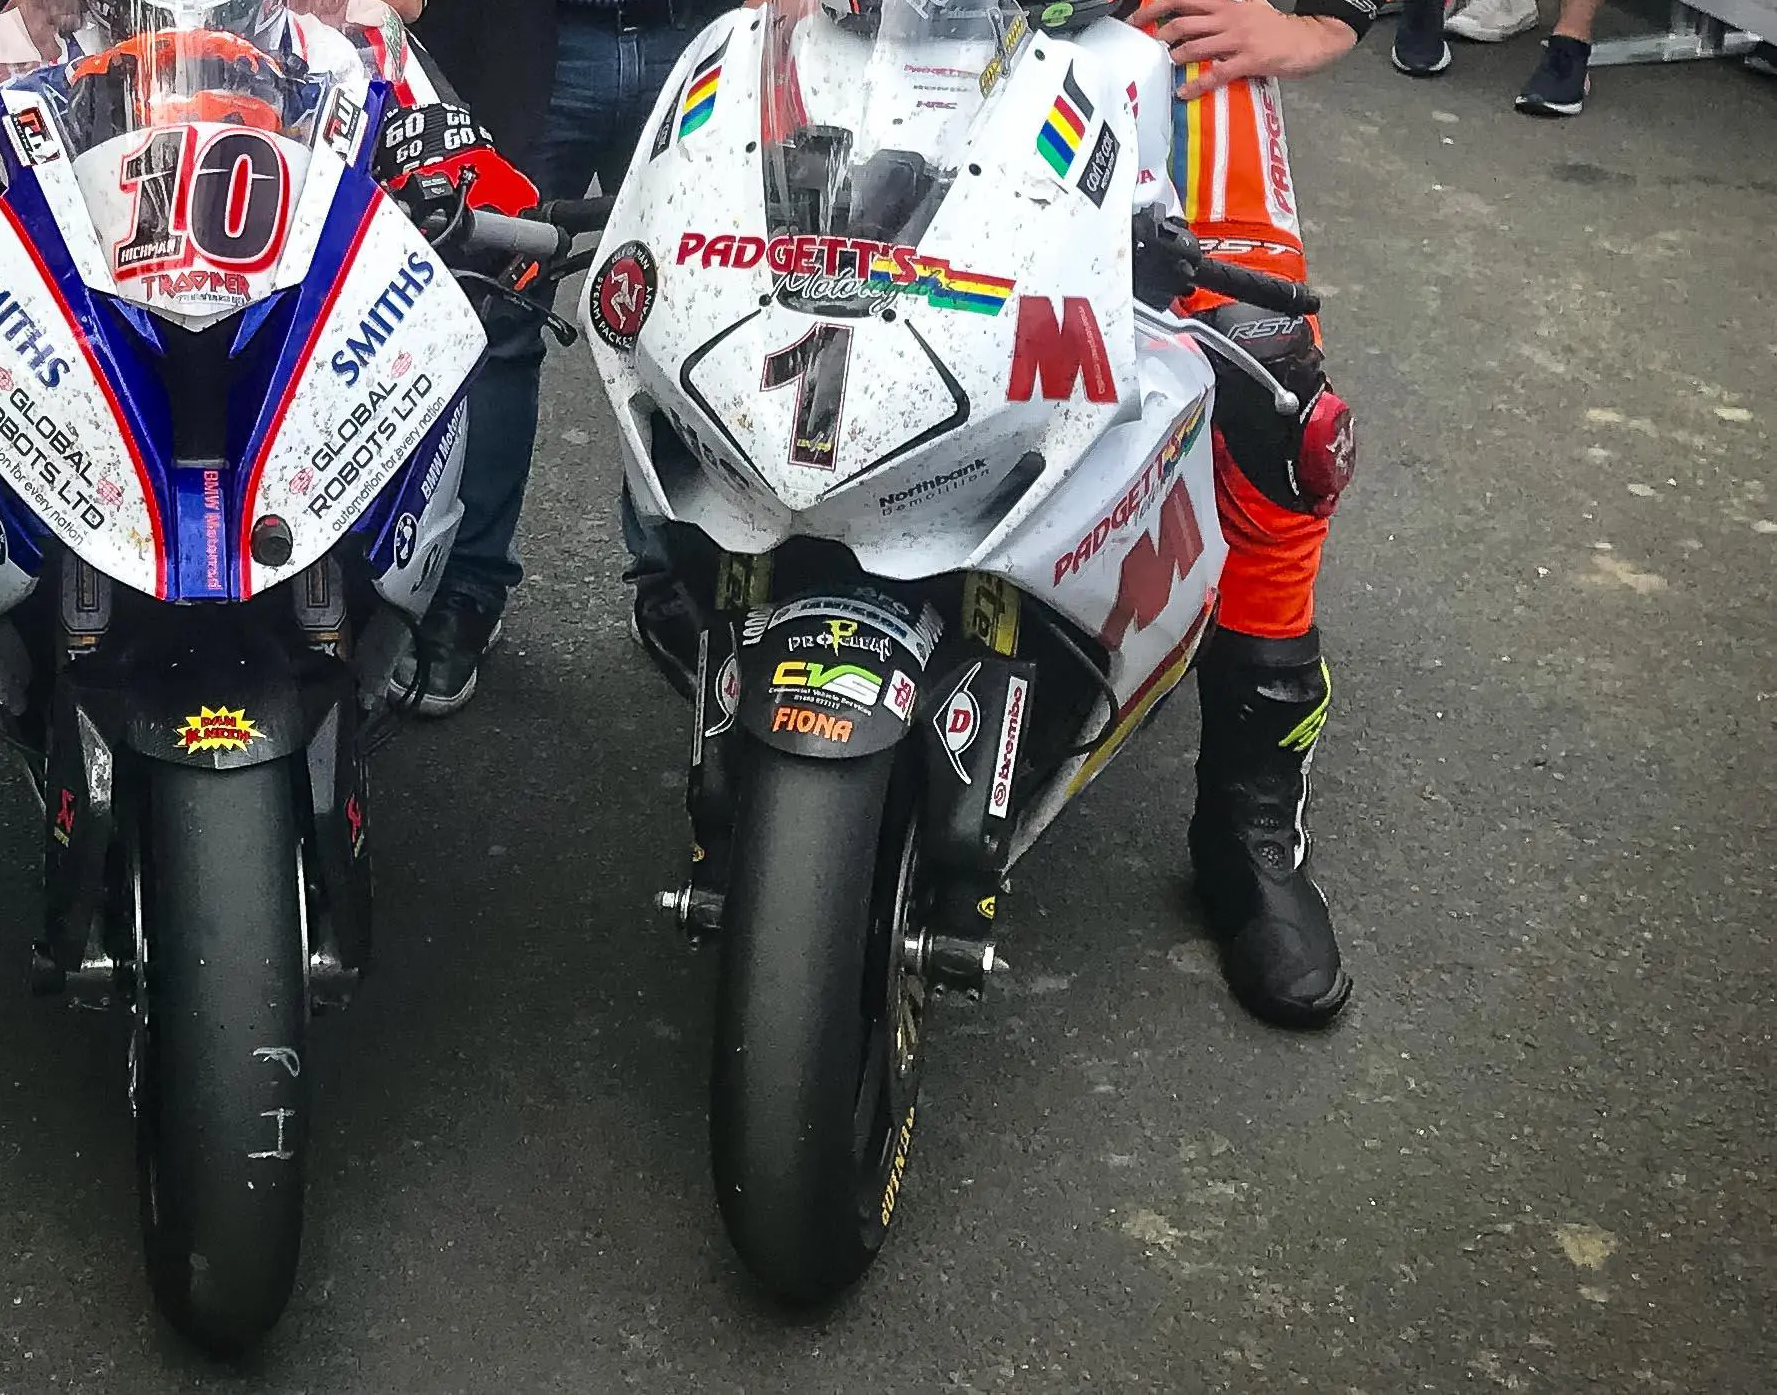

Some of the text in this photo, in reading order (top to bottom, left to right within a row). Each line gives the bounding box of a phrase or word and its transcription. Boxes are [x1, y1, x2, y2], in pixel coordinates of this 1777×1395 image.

[386, 112, 424, 147] 60
[397, 140, 423, 163] 60
[444, 127, 477, 149] 60
[115, 124, 292, 274] 10
[676, 231, 920, 284] PADGETT'S
[331, 251, 435, 387] SMITHS
[1226, 315, 1304, 342] RST
[392, 373, 433, 422] LTD
[759, 320, 854, 471] 1
[9, 387, 93, 487] GLOBAL
[311, 381, 397, 473] GLOBAL
[309, 422, 397, 519] ROBOTS
[332, 395, 446, 533] automation for every nation
[421, 459, 444, 504] BMW
[878, 457, 990, 508] Northbank
[10, 461, 26, 484] for
[24, 480, 54, 520] every
[50, 511, 84, 545] nation
[58, 478, 105, 531] LTD
[203, 470, 221, 511] BMW
[881, 467, 991, 517] Demolition
[772, 661, 883, 706] CVS
[771, 706, 855, 744] FIONA
[948, 708, 972, 735] D
[998, 685, 1023, 781] brembo
